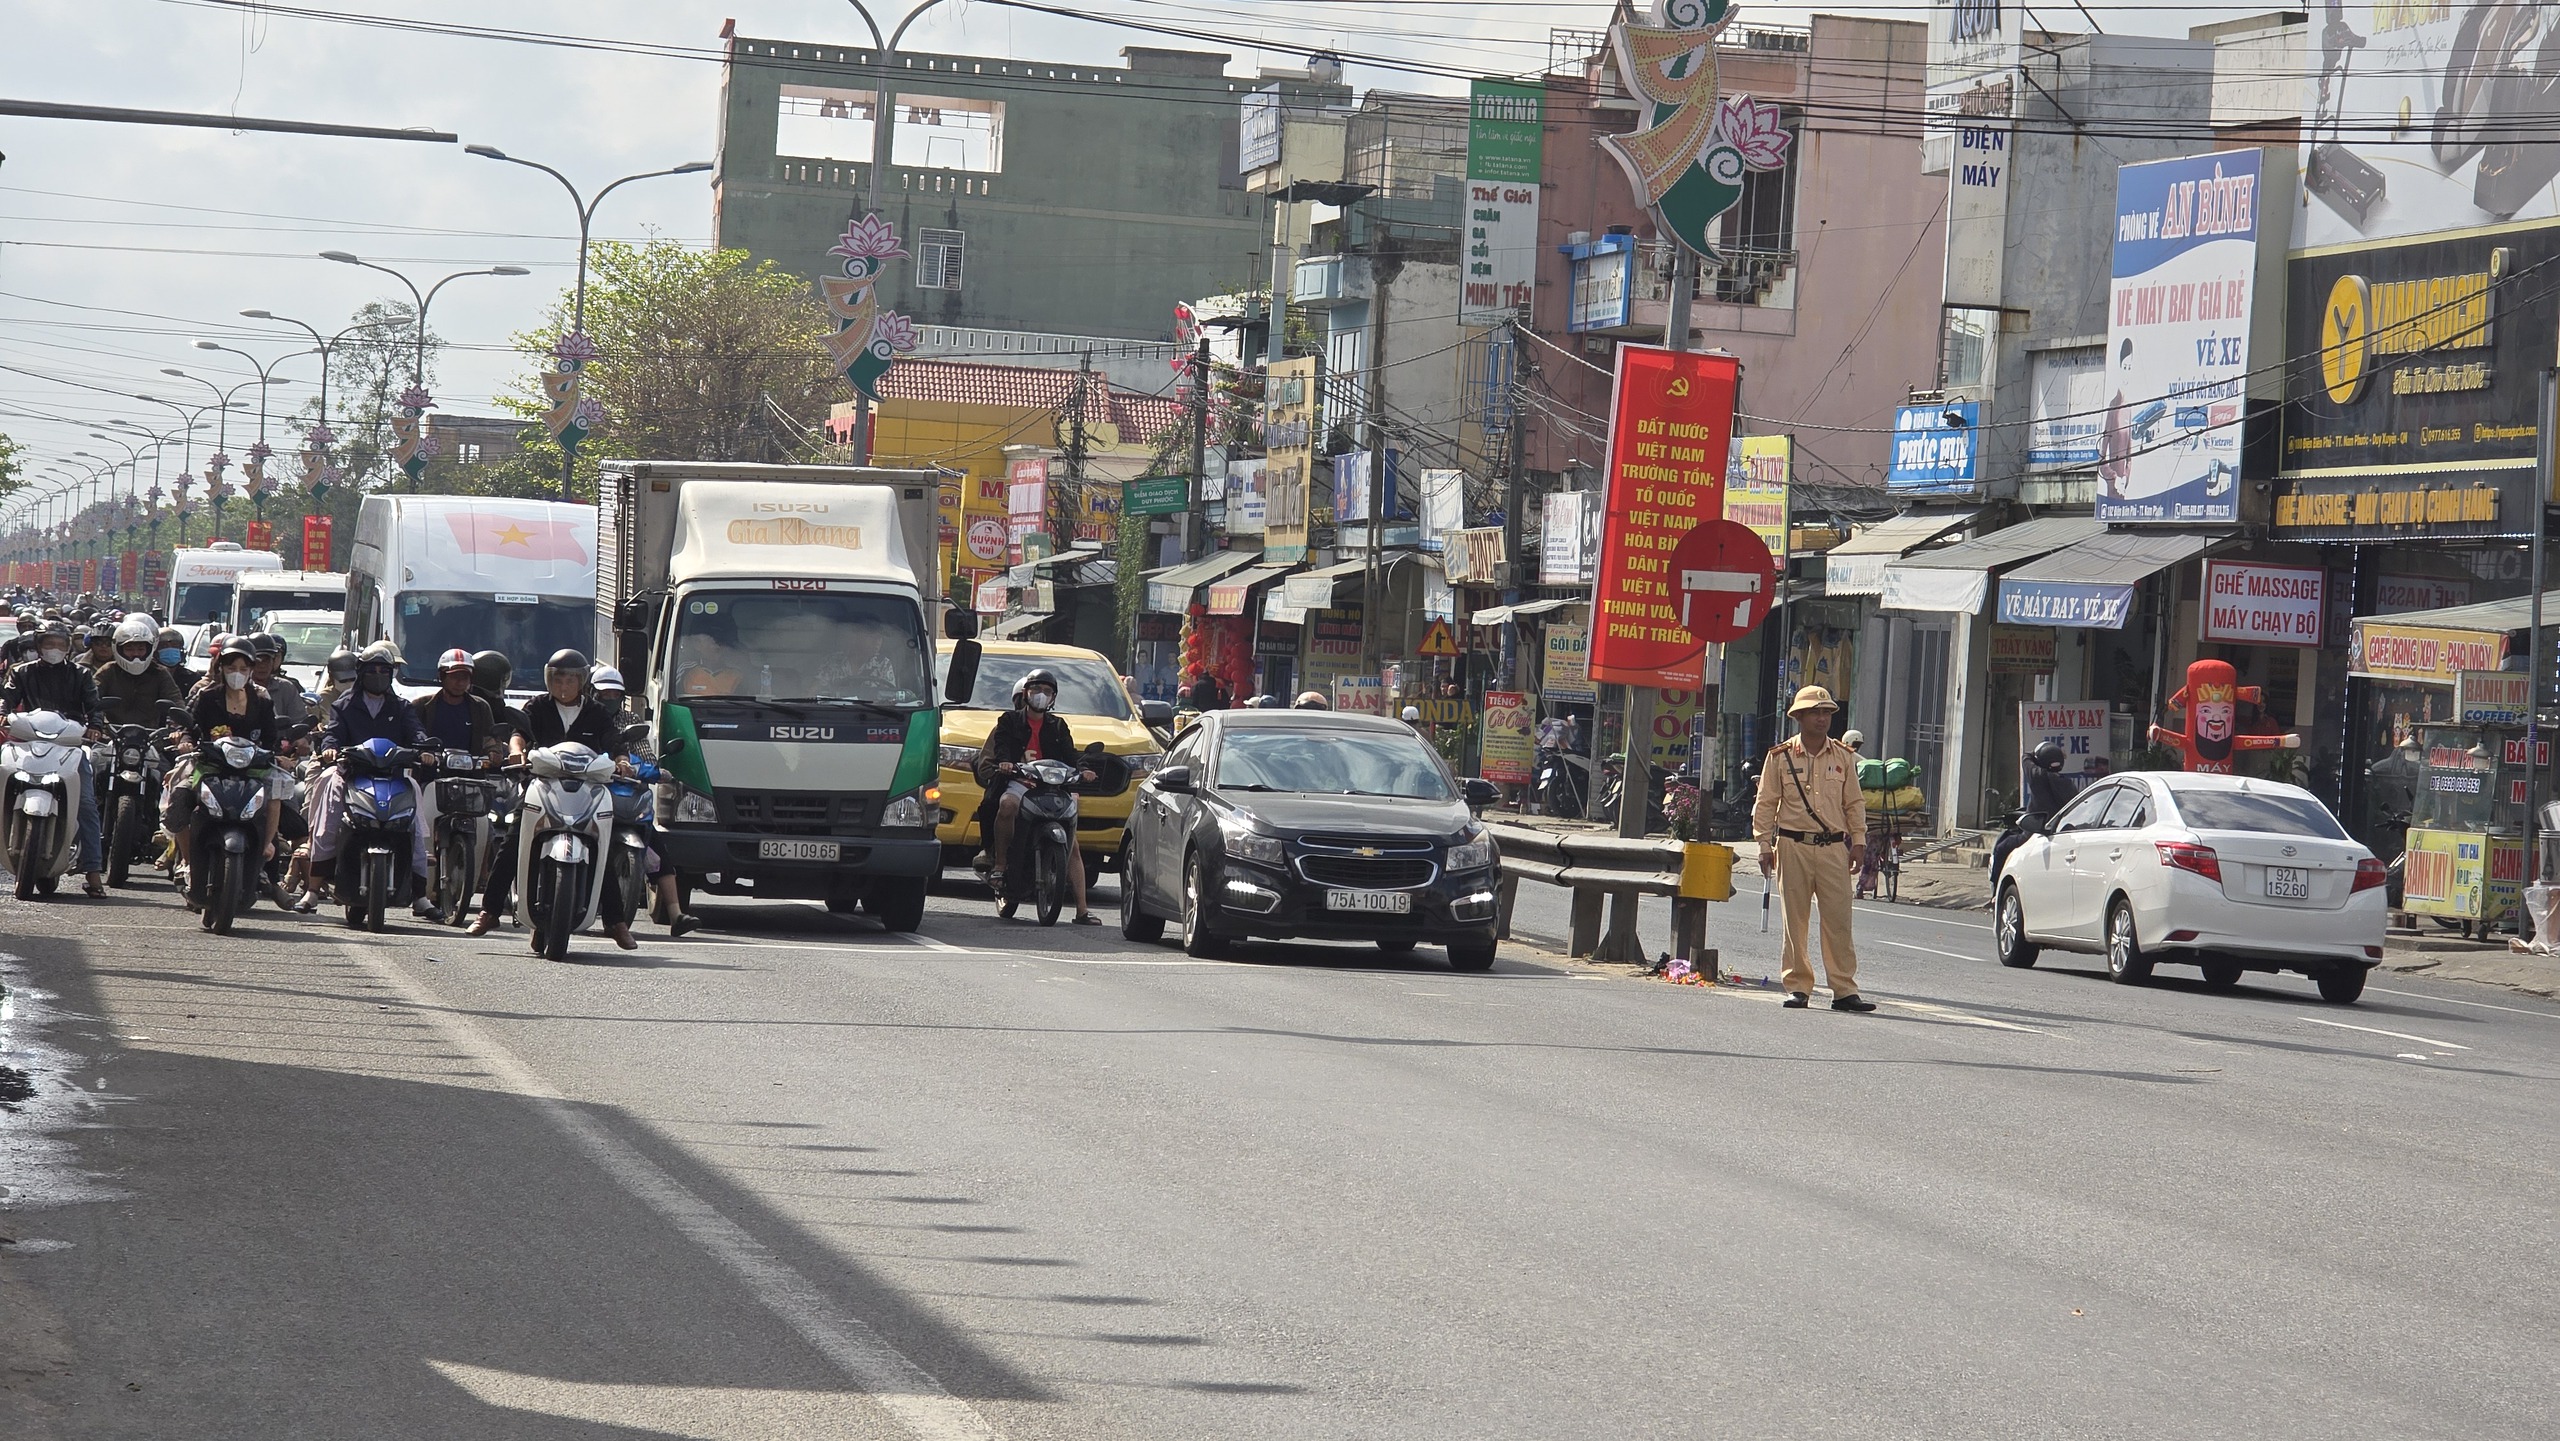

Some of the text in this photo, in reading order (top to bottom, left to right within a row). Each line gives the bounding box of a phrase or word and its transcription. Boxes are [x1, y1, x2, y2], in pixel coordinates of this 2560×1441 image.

[1476, 94, 1537, 124] TATANA
[1962, 124, 2004, 154] ĐIỆN
[1485, 155, 1531, 163] www.tatana.vn
[1962, 161, 2000, 188] MÁY
[1472, 186, 1500, 203] Thế
[2119, 161, 2255, 242] PHÒNG VÉ AN BÌNH
[1472, 227, 1486, 239] GA
[1503, 280, 1532, 308] TIẾN
[2117, 270, 2245, 326] VÉ MÁY BAY GIÁ RẺ
[2371, 273, 2489, 355] YAMAGUCHI
[2196, 330, 2242, 367] VÉ XE
[1638, 416, 1708, 440] ĐẤT NƯỚC
[1637, 441, 1705, 462] VIỆT NAM
[1897, 430, 1969, 476] PHÚC HUỆ
[1622, 463, 1715, 488] TRƯỜNG TỒN;
[1636, 484, 1696, 507] TỔ QUỐC
[2276, 482, 2298, 527] GHẾ
[2298, 493, 2349, 526] MASSAGE
[2356, 486, 2379, 525] MÁY
[2380, 492, 2408, 530] CHẠY
[2409, 484, 2425, 530] BỘ
[2427, 483, 2461, 523] CHÍNH
[753, 503, 829, 513] ISUZU
[1629, 509, 1697, 530] VIỆT NAM
[727, 517, 863, 550] Gia Khang
[970, 534, 1005, 546] HUỲNH
[1624, 531, 1653, 549] HÒA
[1627, 555, 1657, 572] DÂN
[771, 579, 827, 590] ISUZU
[1622, 577, 1652, 596] VIỆT
[2215, 569, 2248, 596] GHẾ
[2247, 575, 2320, 600] MASSAGE
[1603, 599, 1646, 617] THỊNH
[2005, 588, 2021, 616] VÉ
[2022, 589, 2051, 618] MÁY
[2083, 592, 2101, 620] VÉ
[2100, 599, 2120, 621] XE
[2213, 604, 2316, 639] MÁY CHẠY BỘ
[1609, 622, 1691, 644] PHÁT TRIỂN
[1550, 636, 1569, 653] GỘI
[2369, 630, 2390, 668] CAFÉ
[2390, 636, 2418, 669] RANG
[2418, 637, 2439, 672] XAY
[2446, 641, 2466, 673] PHA
[2468, 637, 2493, 671] MÁY
[1342, 677, 1383, 688] A. MIN
[2465, 675, 2503, 704] BÁNH
[1338, 690, 1382, 712] BÁN
[2028, 705, 2104, 728] VÉ MÁY BAY
[2464, 710, 2512, 721] COFFEE
[770, 726, 834, 740] ISUZU
[2070, 736, 2090, 754] XE
[2505, 737, 2549, 765] BÁH
[2196, 762, 2231, 773] MÁY
[762, 842, 837, 859] 93C-109.65
[2276, 868, 2298, 883] 92A
[2268, 882, 2307, 897] 152.60
[1331, 892, 1407, 911] 75A-100.19
